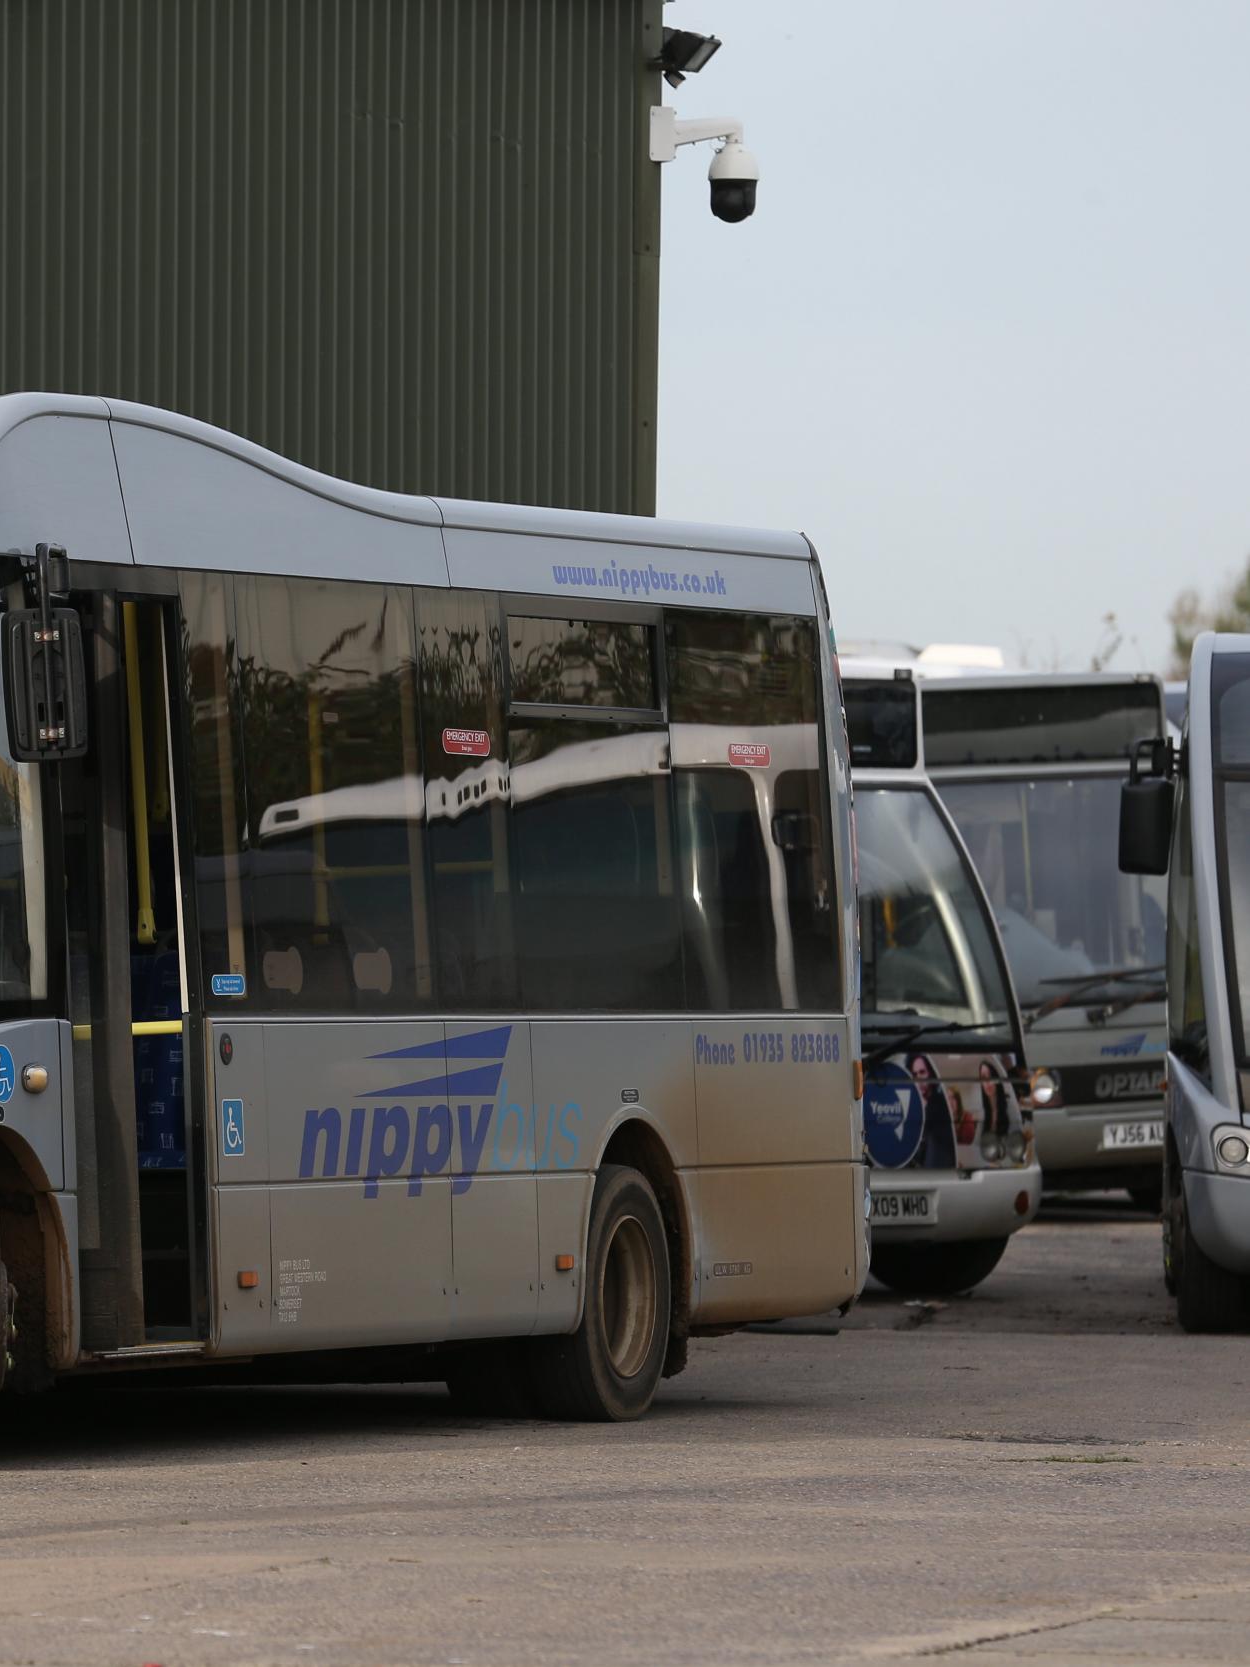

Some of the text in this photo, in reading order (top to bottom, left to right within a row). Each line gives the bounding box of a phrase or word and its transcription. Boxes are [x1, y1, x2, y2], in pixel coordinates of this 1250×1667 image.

[552, 559, 727, 596] www.nippybus.co.uk
[446, 731, 485, 743] EMERGENCY EXIT
[731, 745, 766, 755] EMERGENCY EXIT
[695, 1032, 840, 1066] Phone 01935 823888
[870, 1101, 900, 1115] Yeovil
[299, 1079, 584, 1200] nippybus
[1110, 1122, 1165, 1144] YJ56 AU
[872, 1195, 898, 1217] X09
